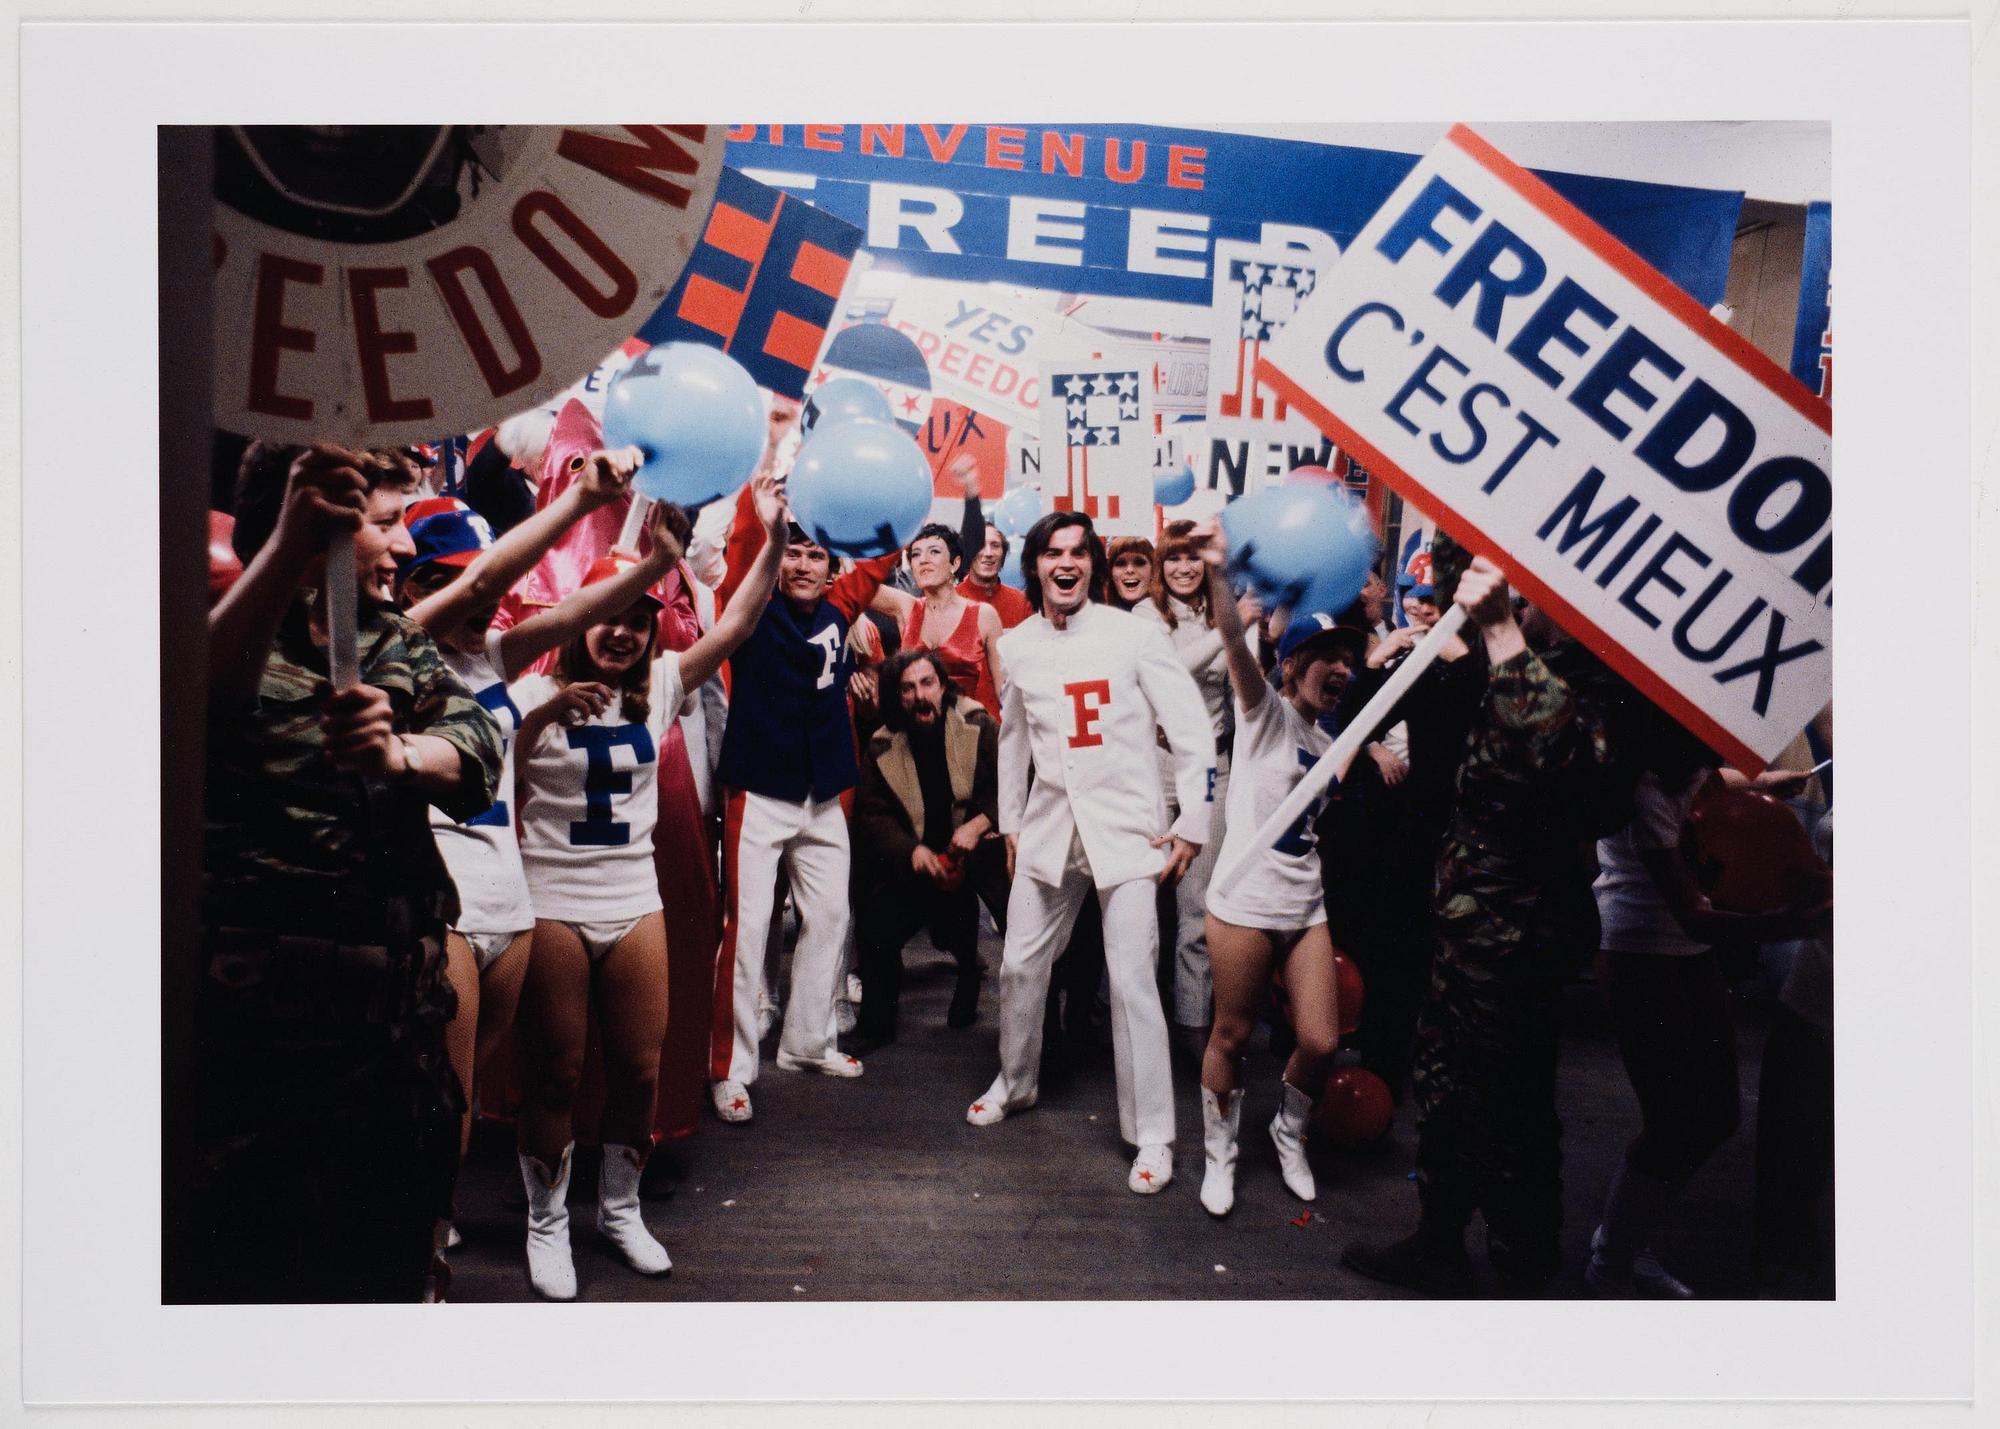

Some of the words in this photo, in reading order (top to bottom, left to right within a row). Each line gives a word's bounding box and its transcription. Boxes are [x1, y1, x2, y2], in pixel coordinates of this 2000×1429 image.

[725, 124, 1208, 190] IENVENUE
[211, 124, 707, 424] EEDOM
[946, 299, 1034, 356] YES
[912, 409, 985, 453] UX
[1324, 302, 1560, 498] C'EST
[1535, 465, 1825, 718] MIEUX
[807, 622, 840, 690] F
[1063, 679, 1112, 749] F
[566, 723, 656, 846] F
